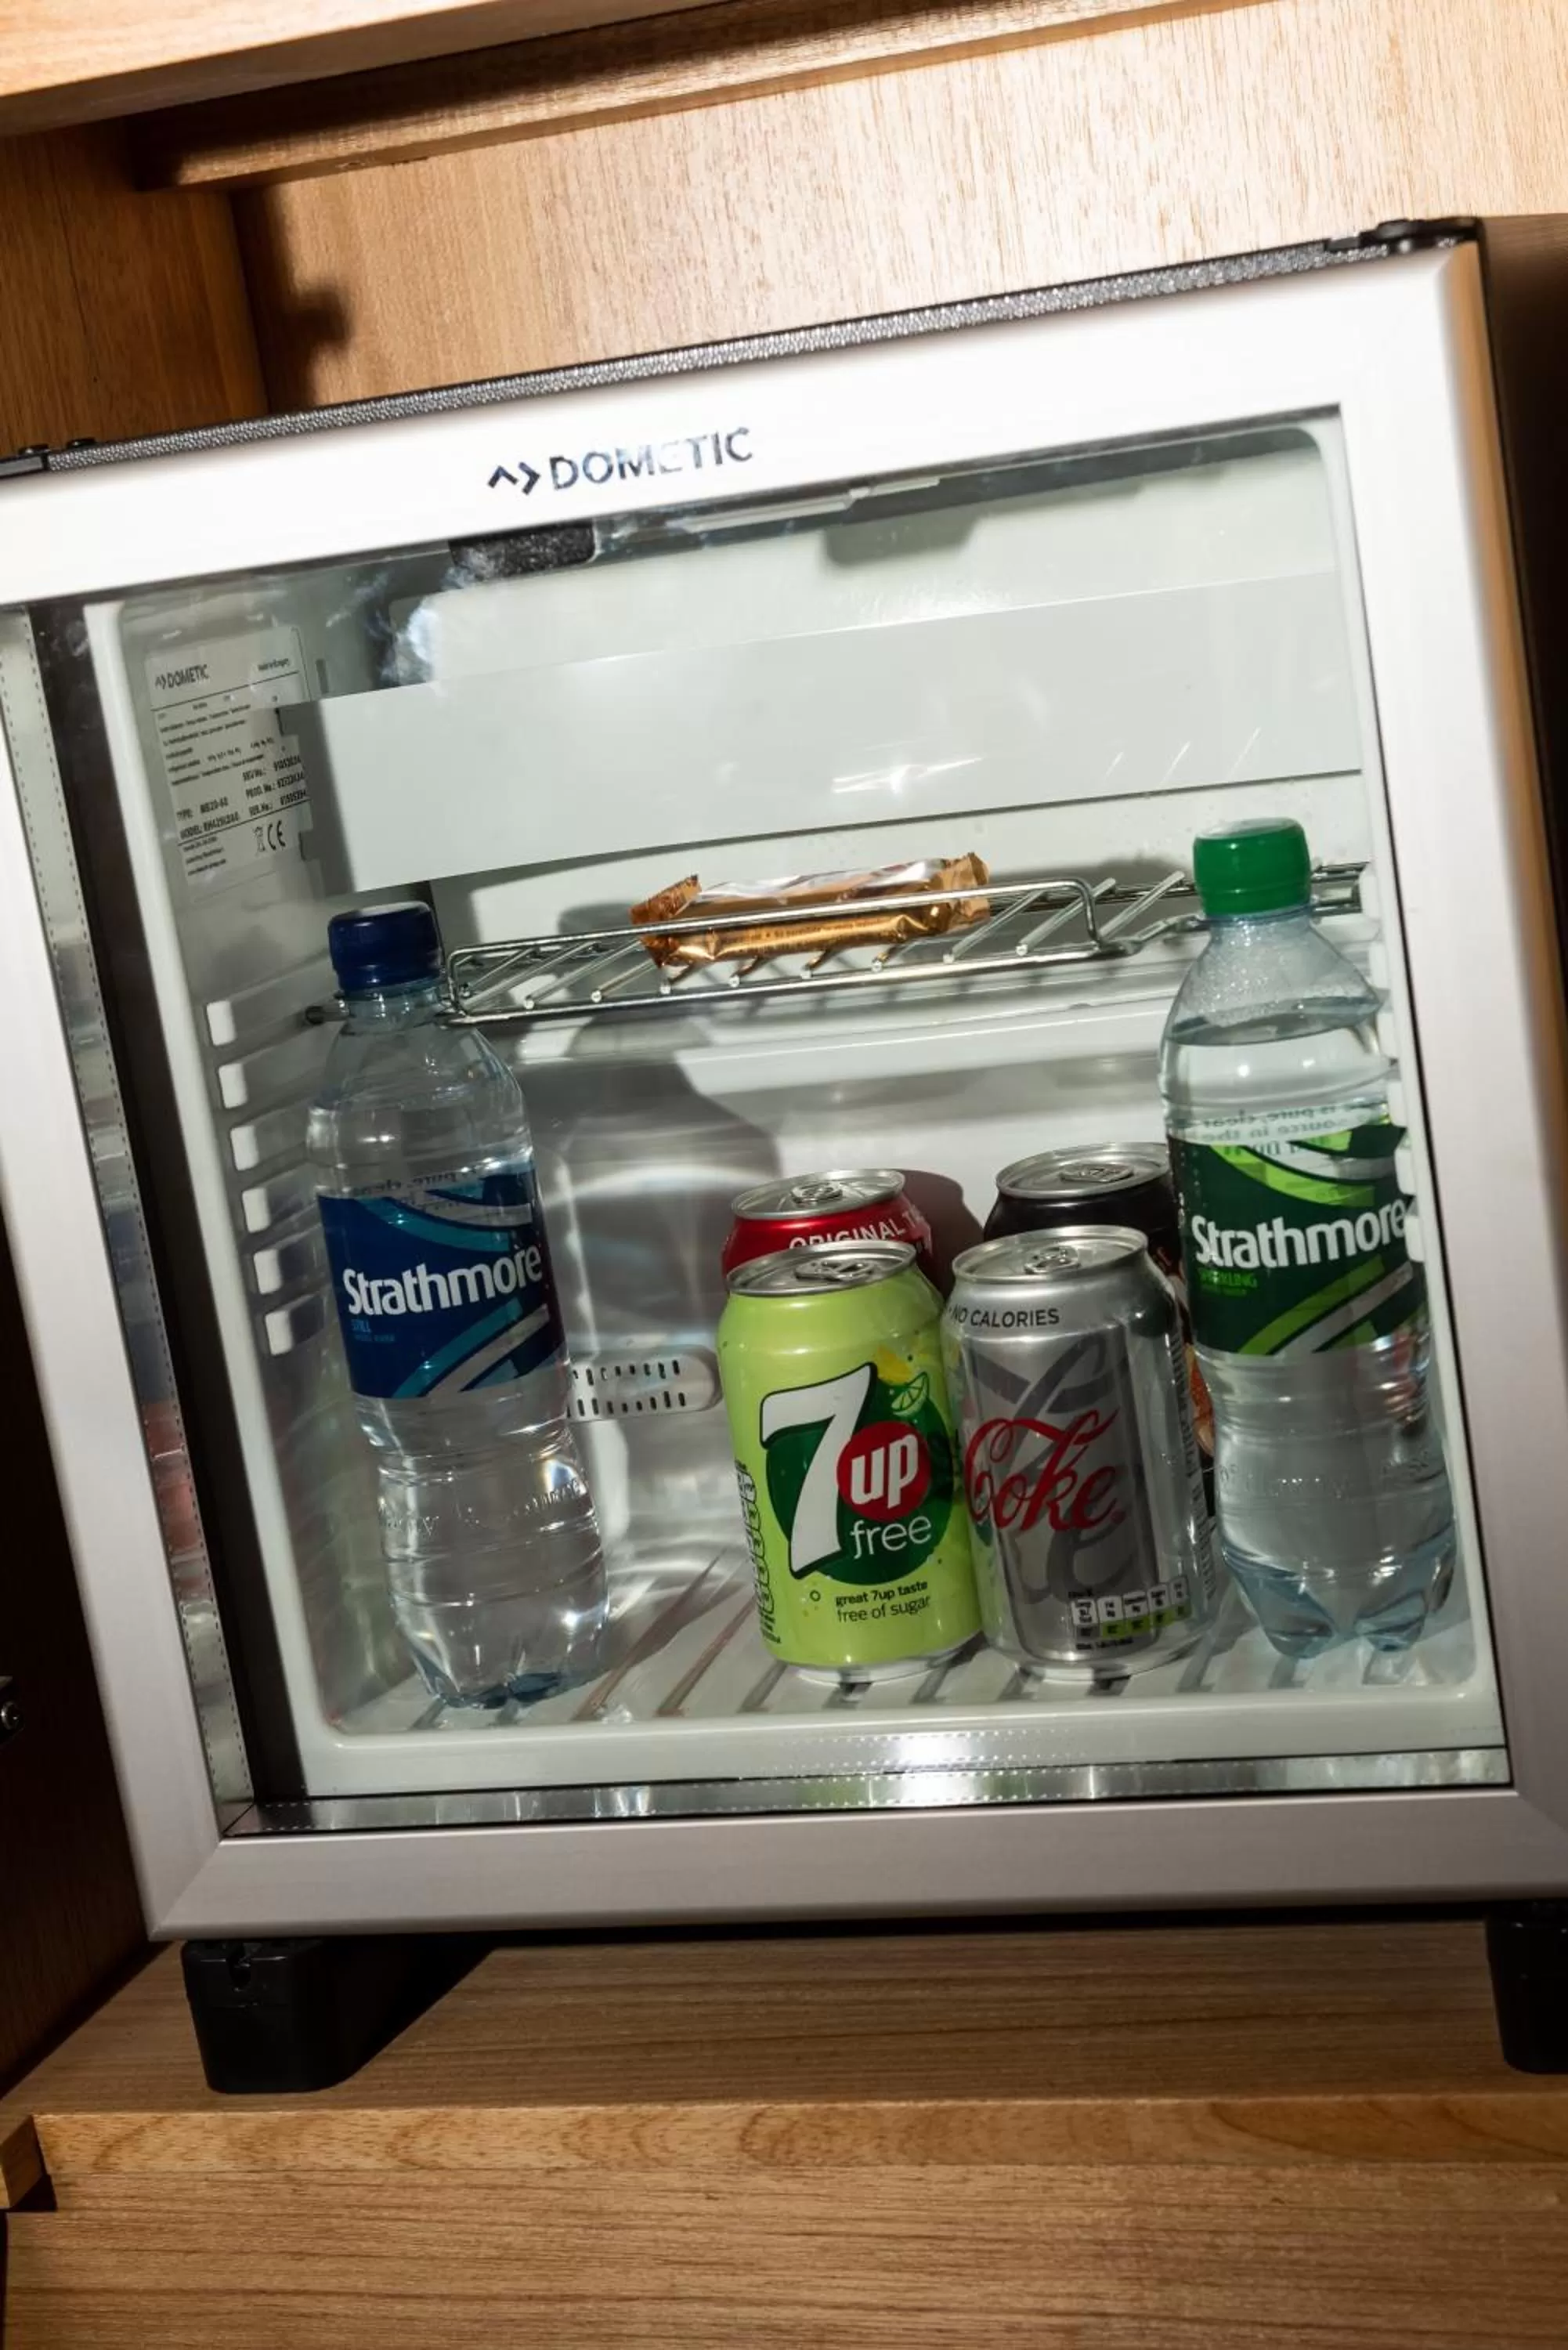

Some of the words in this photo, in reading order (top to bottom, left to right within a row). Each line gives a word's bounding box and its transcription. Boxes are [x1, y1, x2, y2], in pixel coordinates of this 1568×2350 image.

[549, 427, 753, 490] DOMETIC
[168, 664, 210, 689] DOMETIC
[1191, 1198, 1405, 1269] Strathmore
[342, 1245, 543, 1316] Strathmore
[970, 1307, 1060, 1328] CALORIES
[964, 1407, 1121, 1532] Coke
[849, 1515, 933, 1560] free
[835, 1591, 869, 1607] great
[869, 1589, 895, 1601] 7up
[897, 1581, 928, 1596] taste
[836, 1608, 868, 1623] free
[871, 1602, 887, 1620] of
[889, 1595, 931, 1617] sugar
